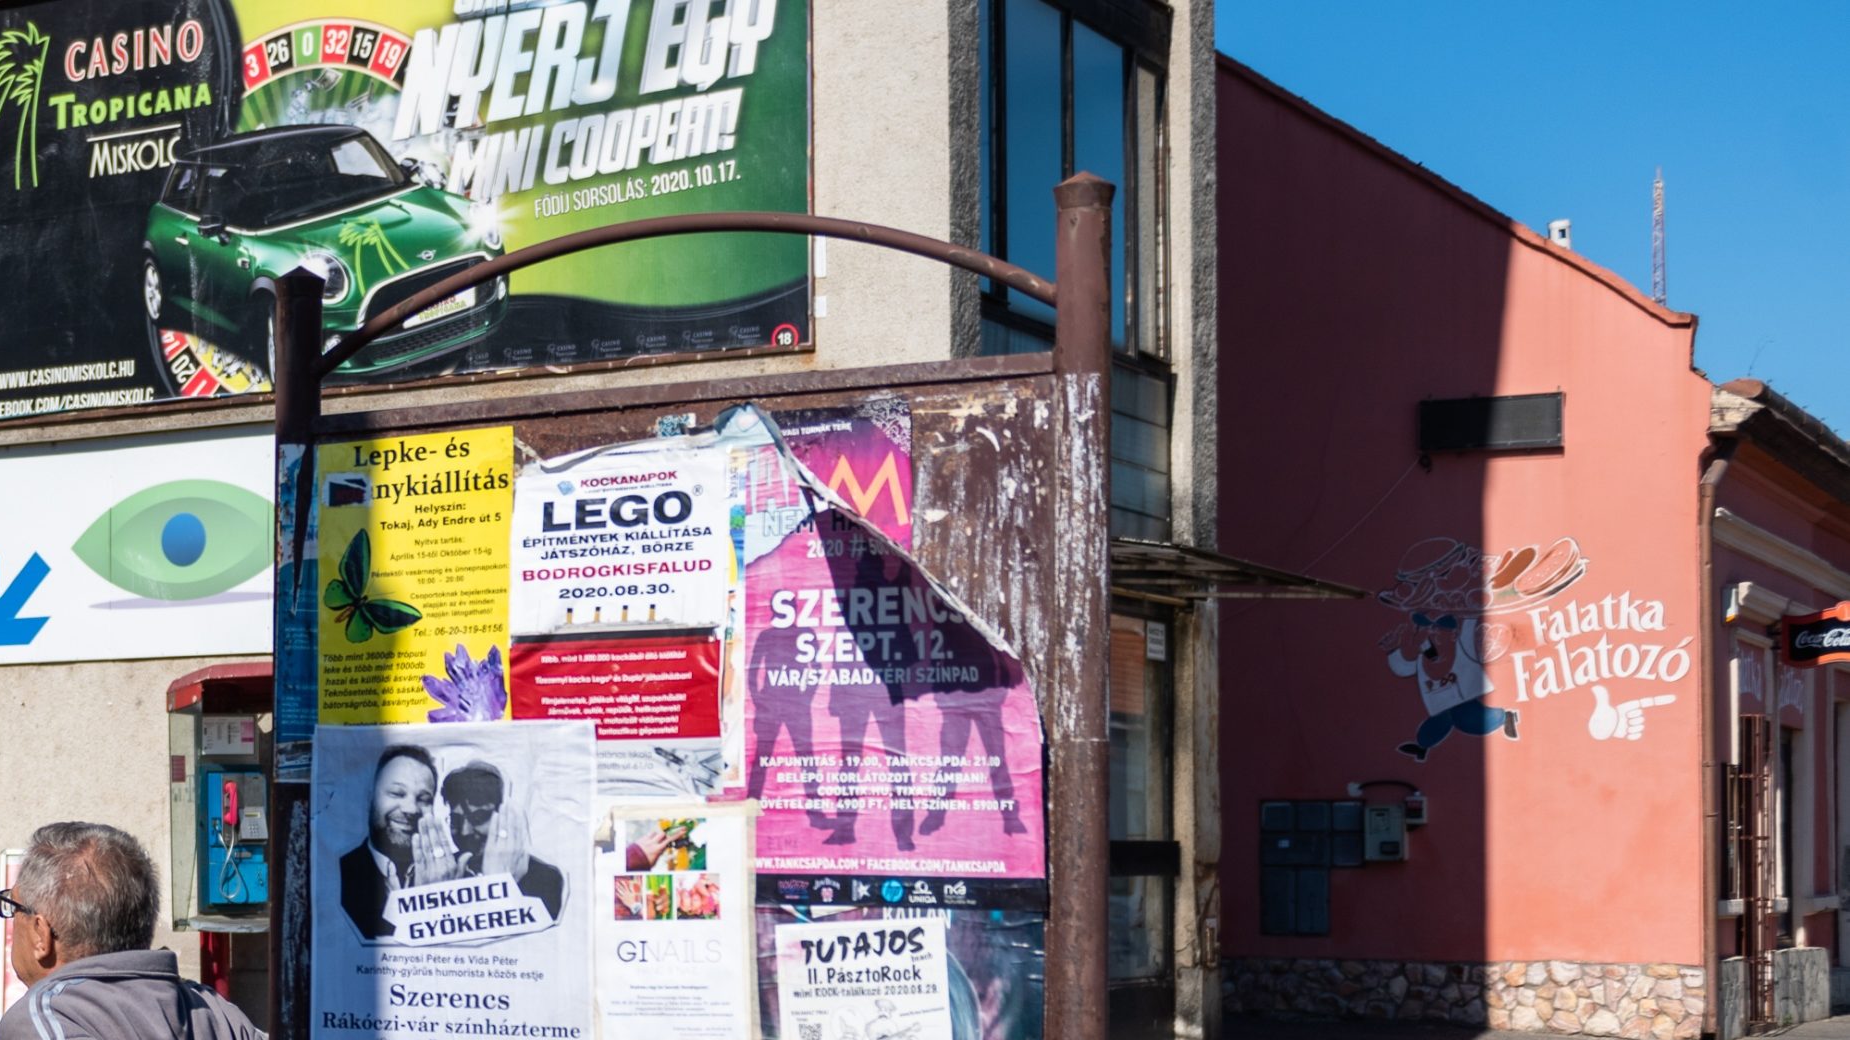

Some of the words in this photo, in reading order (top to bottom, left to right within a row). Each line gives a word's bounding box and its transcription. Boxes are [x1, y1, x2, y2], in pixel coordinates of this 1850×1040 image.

[64, 20, 204, 82] CASINO
[245, 53, 260, 77] 3
[267, 39, 290, 67] 26
[302, 32, 314, 56] 0
[325, 29, 345, 54] 32
[352, 32, 374, 59] 15
[378, 40, 401, 69] 19
[392, 0, 630, 140] NYERJ
[640, 0, 779, 94] EGY
[48, 83, 212, 130] TROPICANA
[89, 135, 181, 178] MISKOLC
[446, 125, 545, 199] MINI
[573, 180, 648, 212] SORSOLÁS:
[651, 160, 742, 197] 2020.10.17.
[778, 332, 792, 345] 18
[782, 428, 800, 436] VAGI
[353, 441, 437, 471] Lepke-
[445, 437, 470, 458] és
[371, 468, 509, 504] nykiállítás
[580, 470, 678, 488] KOCKANAPOK
[380, 520, 414, 531] Tokaj,
[417, 518, 438, 528] Ady
[443, 516, 475, 526] Endre
[479, 514, 490, 523] út
[495, 512, 501, 521] 5
[542, 490, 693, 533] LEGO
[414, 539, 438, 547] Nyitva
[522, 532, 620, 549] ÉPÍTMÉNYEK
[625, 526, 713, 542] KIÁLLÍTÁSA
[474, 547, 492, 555] 15-ig
[541, 545, 635, 561] JÁTSZÓHÁZ,
[522, 559, 712, 582] BODROGKISFALUD
[558, 583, 676, 599] 2020.08.30.
[1527, 590, 1666, 646] Falatka
[414, 628, 432, 637] Tel.:
[435, 624, 503, 635] 06-20-319-8156
[795, 631, 902, 664] SZEPT.
[913, 630, 954, 660] 12.
[915, 664, 979, 683] SZÍNPAD
[1511, 635, 1695, 704] Falatozó
[759, 755, 836, 767] KAPUNYITÁS
[886, 756, 972, 768] TANKCSAPDA:
[837, 800, 866, 810] 4900
[868, 800, 887, 811] FT,
[1001, 801, 1015, 811] FT
[398, 881, 509, 914] MISKOLCI
[909, 895, 937, 904] UNIQA
[409, 906, 536, 940] GYÖKEREK
[801, 926, 925, 965] TUTAJOS
[381, 953, 424, 964] Aranyosi
[454, 955, 465, 964] és
[469, 955, 489, 965] Vida
[435, 967, 485, 978] humorista
[487, 969, 517, 979] közös
[520, 971, 544, 981] estje
[808, 968, 823, 985] II.
[827, 964, 922, 984] PásztoRock
[389, 984, 510, 1010] Szerencs
[793, 988, 813, 998] mini
[322, 1011, 439, 1033] Rákóczi-vár
[445, 1015, 581, 1039] színházterme
